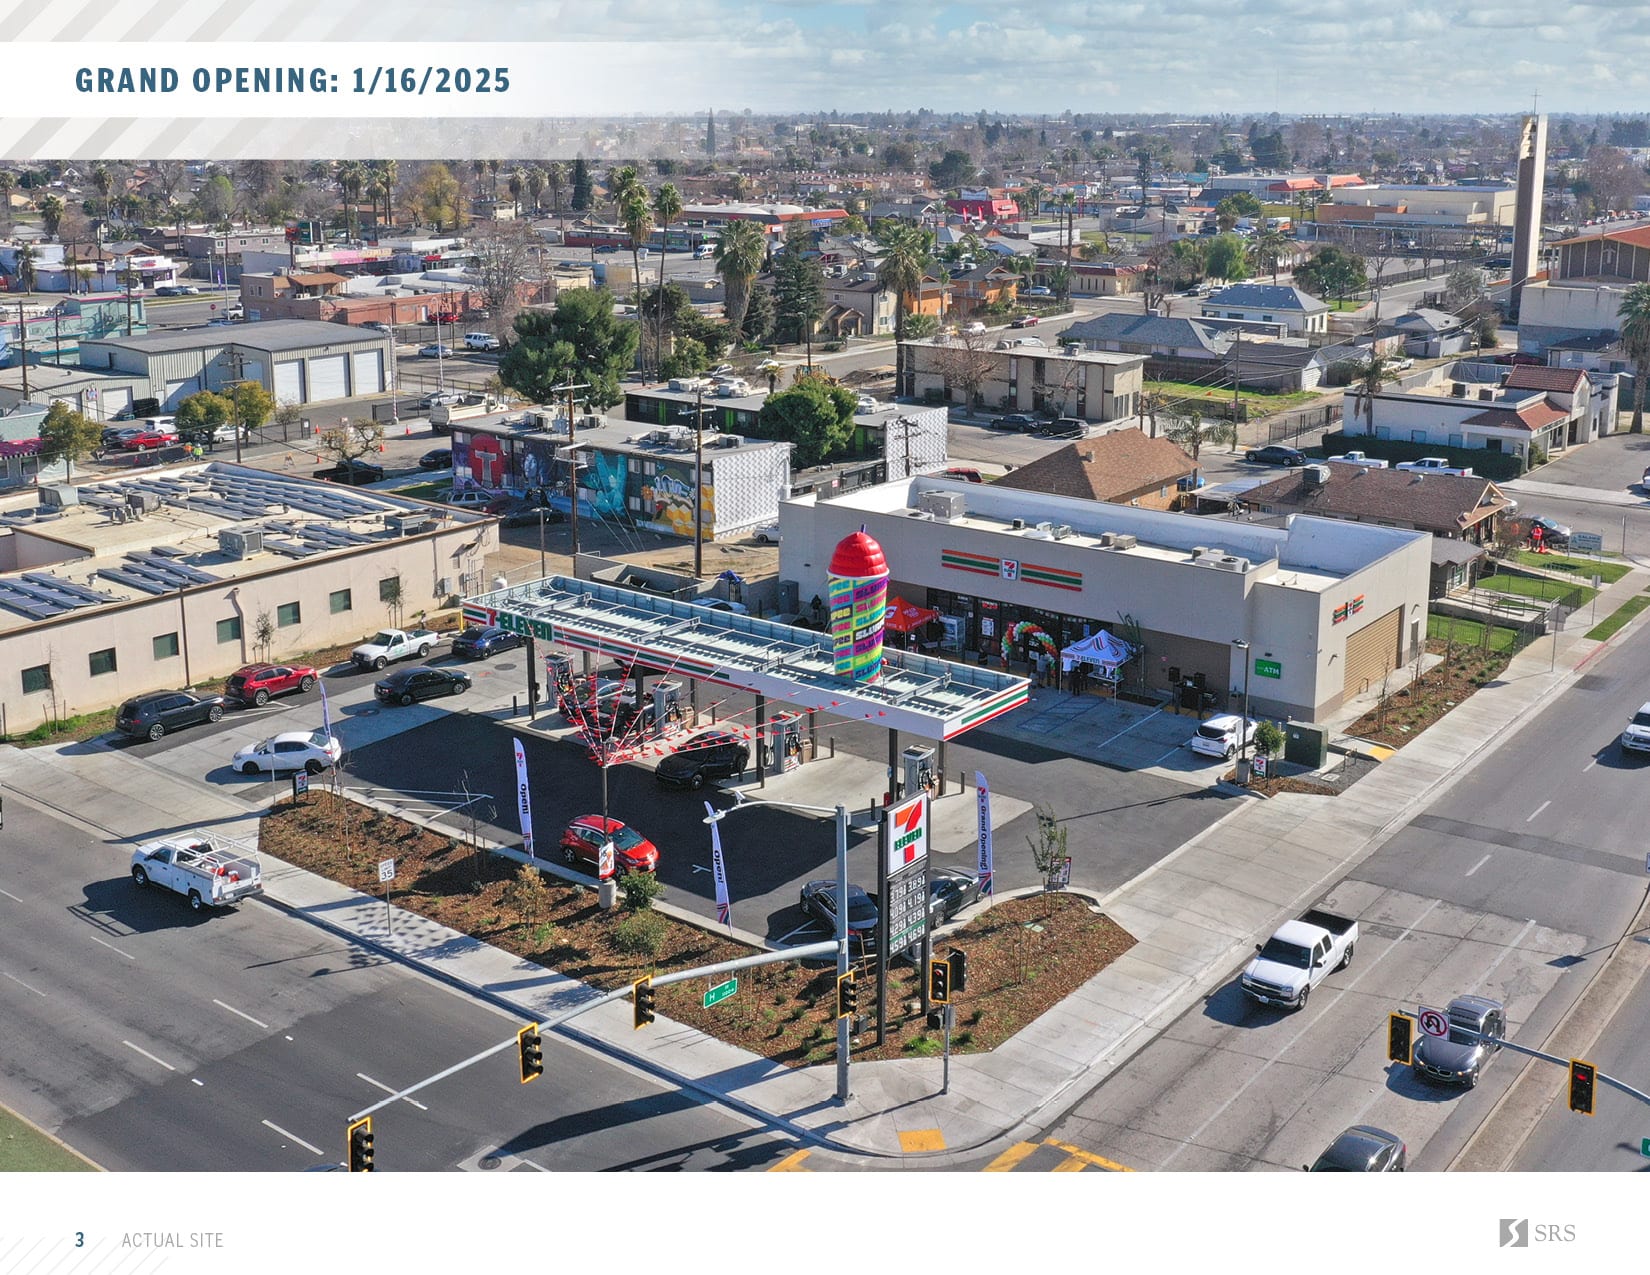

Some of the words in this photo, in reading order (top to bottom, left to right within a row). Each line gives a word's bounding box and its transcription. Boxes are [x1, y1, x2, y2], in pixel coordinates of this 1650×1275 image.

[1263, 666, 1280, 675] ATM
[895, 799, 923, 864] 7
[381, 869, 393, 880] 35
[709, 992, 715, 1002] H
